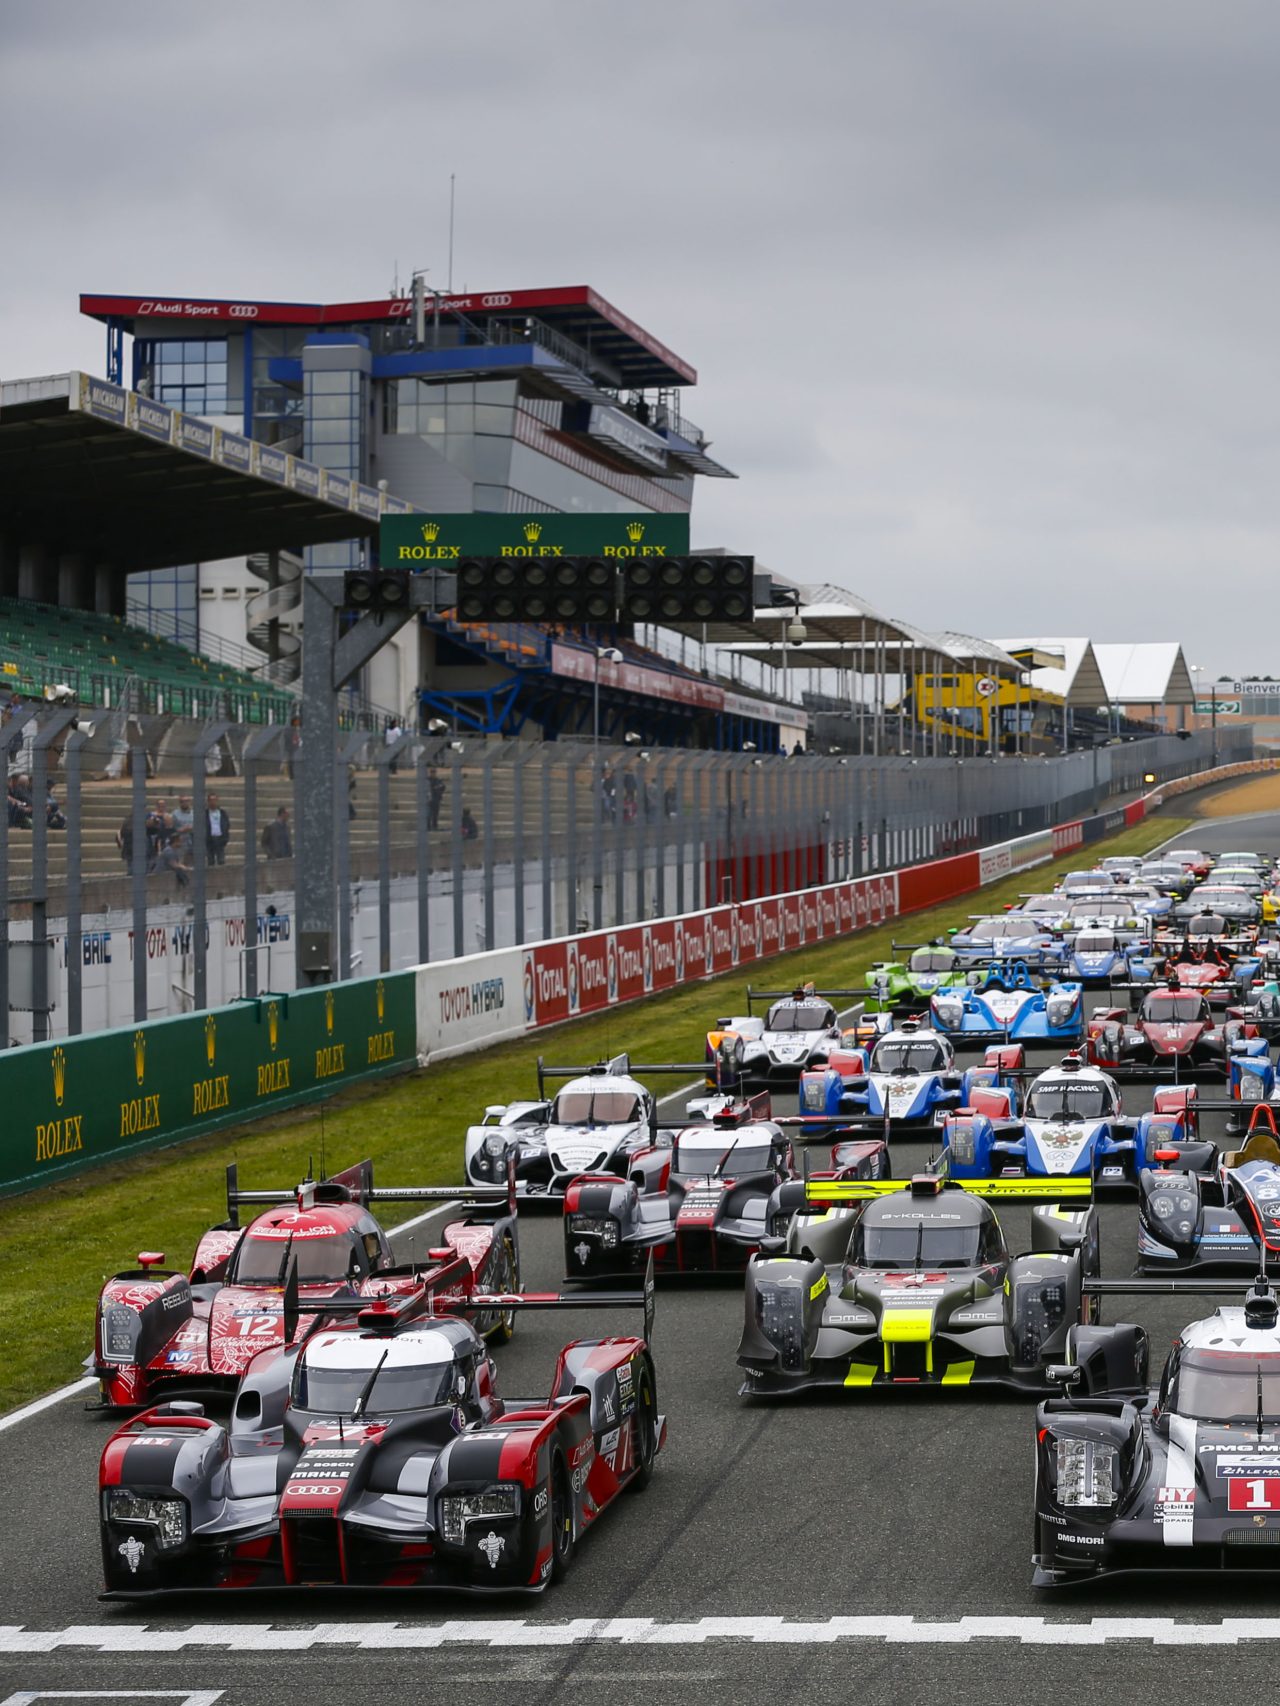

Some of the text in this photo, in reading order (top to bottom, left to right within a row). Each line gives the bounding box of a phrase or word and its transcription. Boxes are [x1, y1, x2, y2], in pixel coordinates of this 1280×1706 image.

[154, 303, 219, 315] Audi Sport
[437, 299, 472, 310] Sport
[399, 546, 461, 559] ROLEX
[501, 546, 563, 557] ROLEX
[603, 546, 666, 557] ROLEX
[653, 938, 675, 970] TOTAL
[684, 931, 705, 963] TOTAL
[618, 946, 643, 980] TOTAL
[579, 954, 607, 990] TOTAL
[536, 964, 567, 1001] TOTAL
[919, 977, 938, 985] 40
[439, 977, 504, 1024] TOYOTA HYBRID
[368, 1031, 395, 1063] ROLEX
[315, 1044, 344, 1078] ROLEX
[257, 1058, 290, 1096] ROLEX
[193, 1075, 229, 1115] ROLEX
[1037, 1085, 1100, 1094] SMP RACING
[120, 1094, 161, 1137] ROLEX
[36, 1115, 83, 1162] ROLEX
[1104, 1168, 1122, 1176] P2
[252, 1225, 335, 1235] REBELLION
[902, 1273, 927, 1284] 4
[235, 1316, 278, 1336] 12
[1199, 1445, 1249, 1454] DMG
[290, 1471, 351, 1479] MAHLE
[1222, 1466, 1245, 1475] 24h
[534, 1488, 548, 1512] ORIS
[1158, 1488, 1195, 1502] HY
[1246, 1479, 1272, 1508] 1
[1057, 1533, 1105, 1545] DMG MORI
